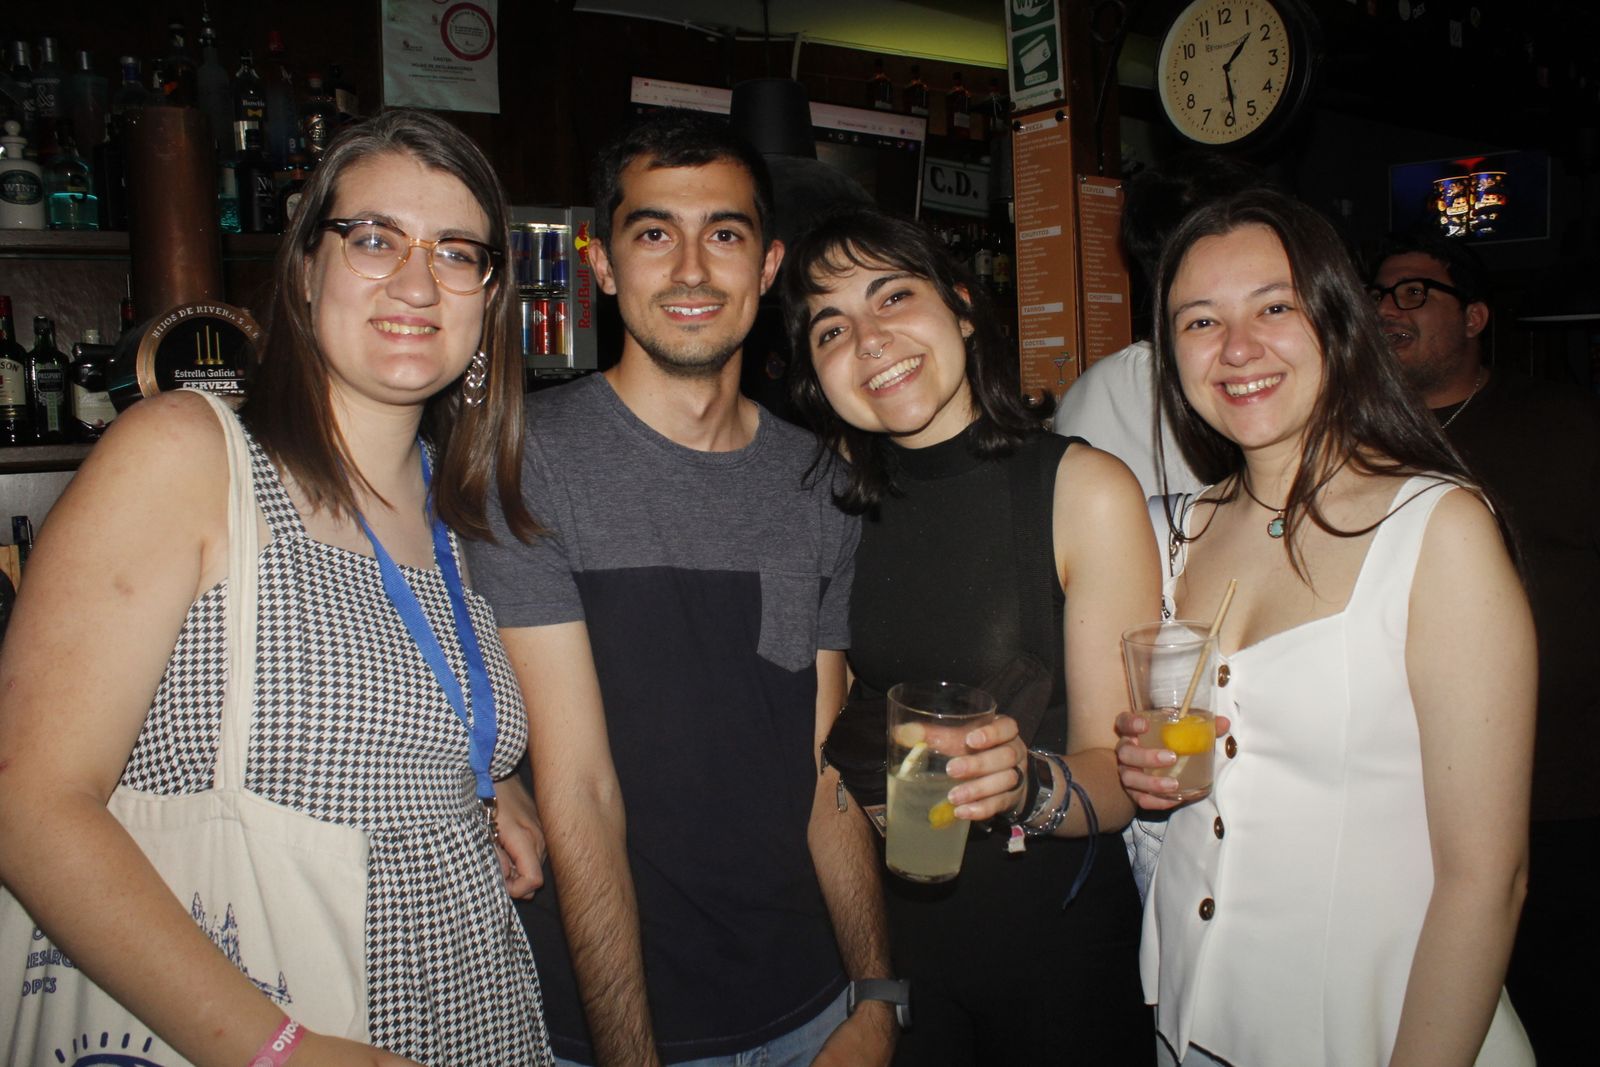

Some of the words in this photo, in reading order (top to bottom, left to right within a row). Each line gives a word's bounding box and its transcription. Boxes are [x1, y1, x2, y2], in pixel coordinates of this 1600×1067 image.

[1217, 8, 1231, 25] 12
[1245, 9, 1250, 25] 1
[1199, 20, 1209, 37] 11
[1260, 24, 1270, 41] 2
[1183, 43, 1195, 60] 10
[1268, 48, 1278, 65] 3
[1180, 71, 1188, 86] 9
[1262, 79, 1272, 93] 4
[1187, 94, 1195, 109] 8
[1247, 100, 1257, 116] 5
[1202, 108, 1212, 125] 7
[1224, 111, 1235, 127] 6
[576, 269, 592, 298] Bull
[151, 314, 178, 339] HIJOS
[178, 307, 194, 318] DE
[196, 305, 236, 320] RIVERA
[576, 300, 592, 329] Red
[174, 369, 206, 378] Estrella
[207, 368, 236, 378] Galicia
[182, 381, 239, 390] CERVEZA
